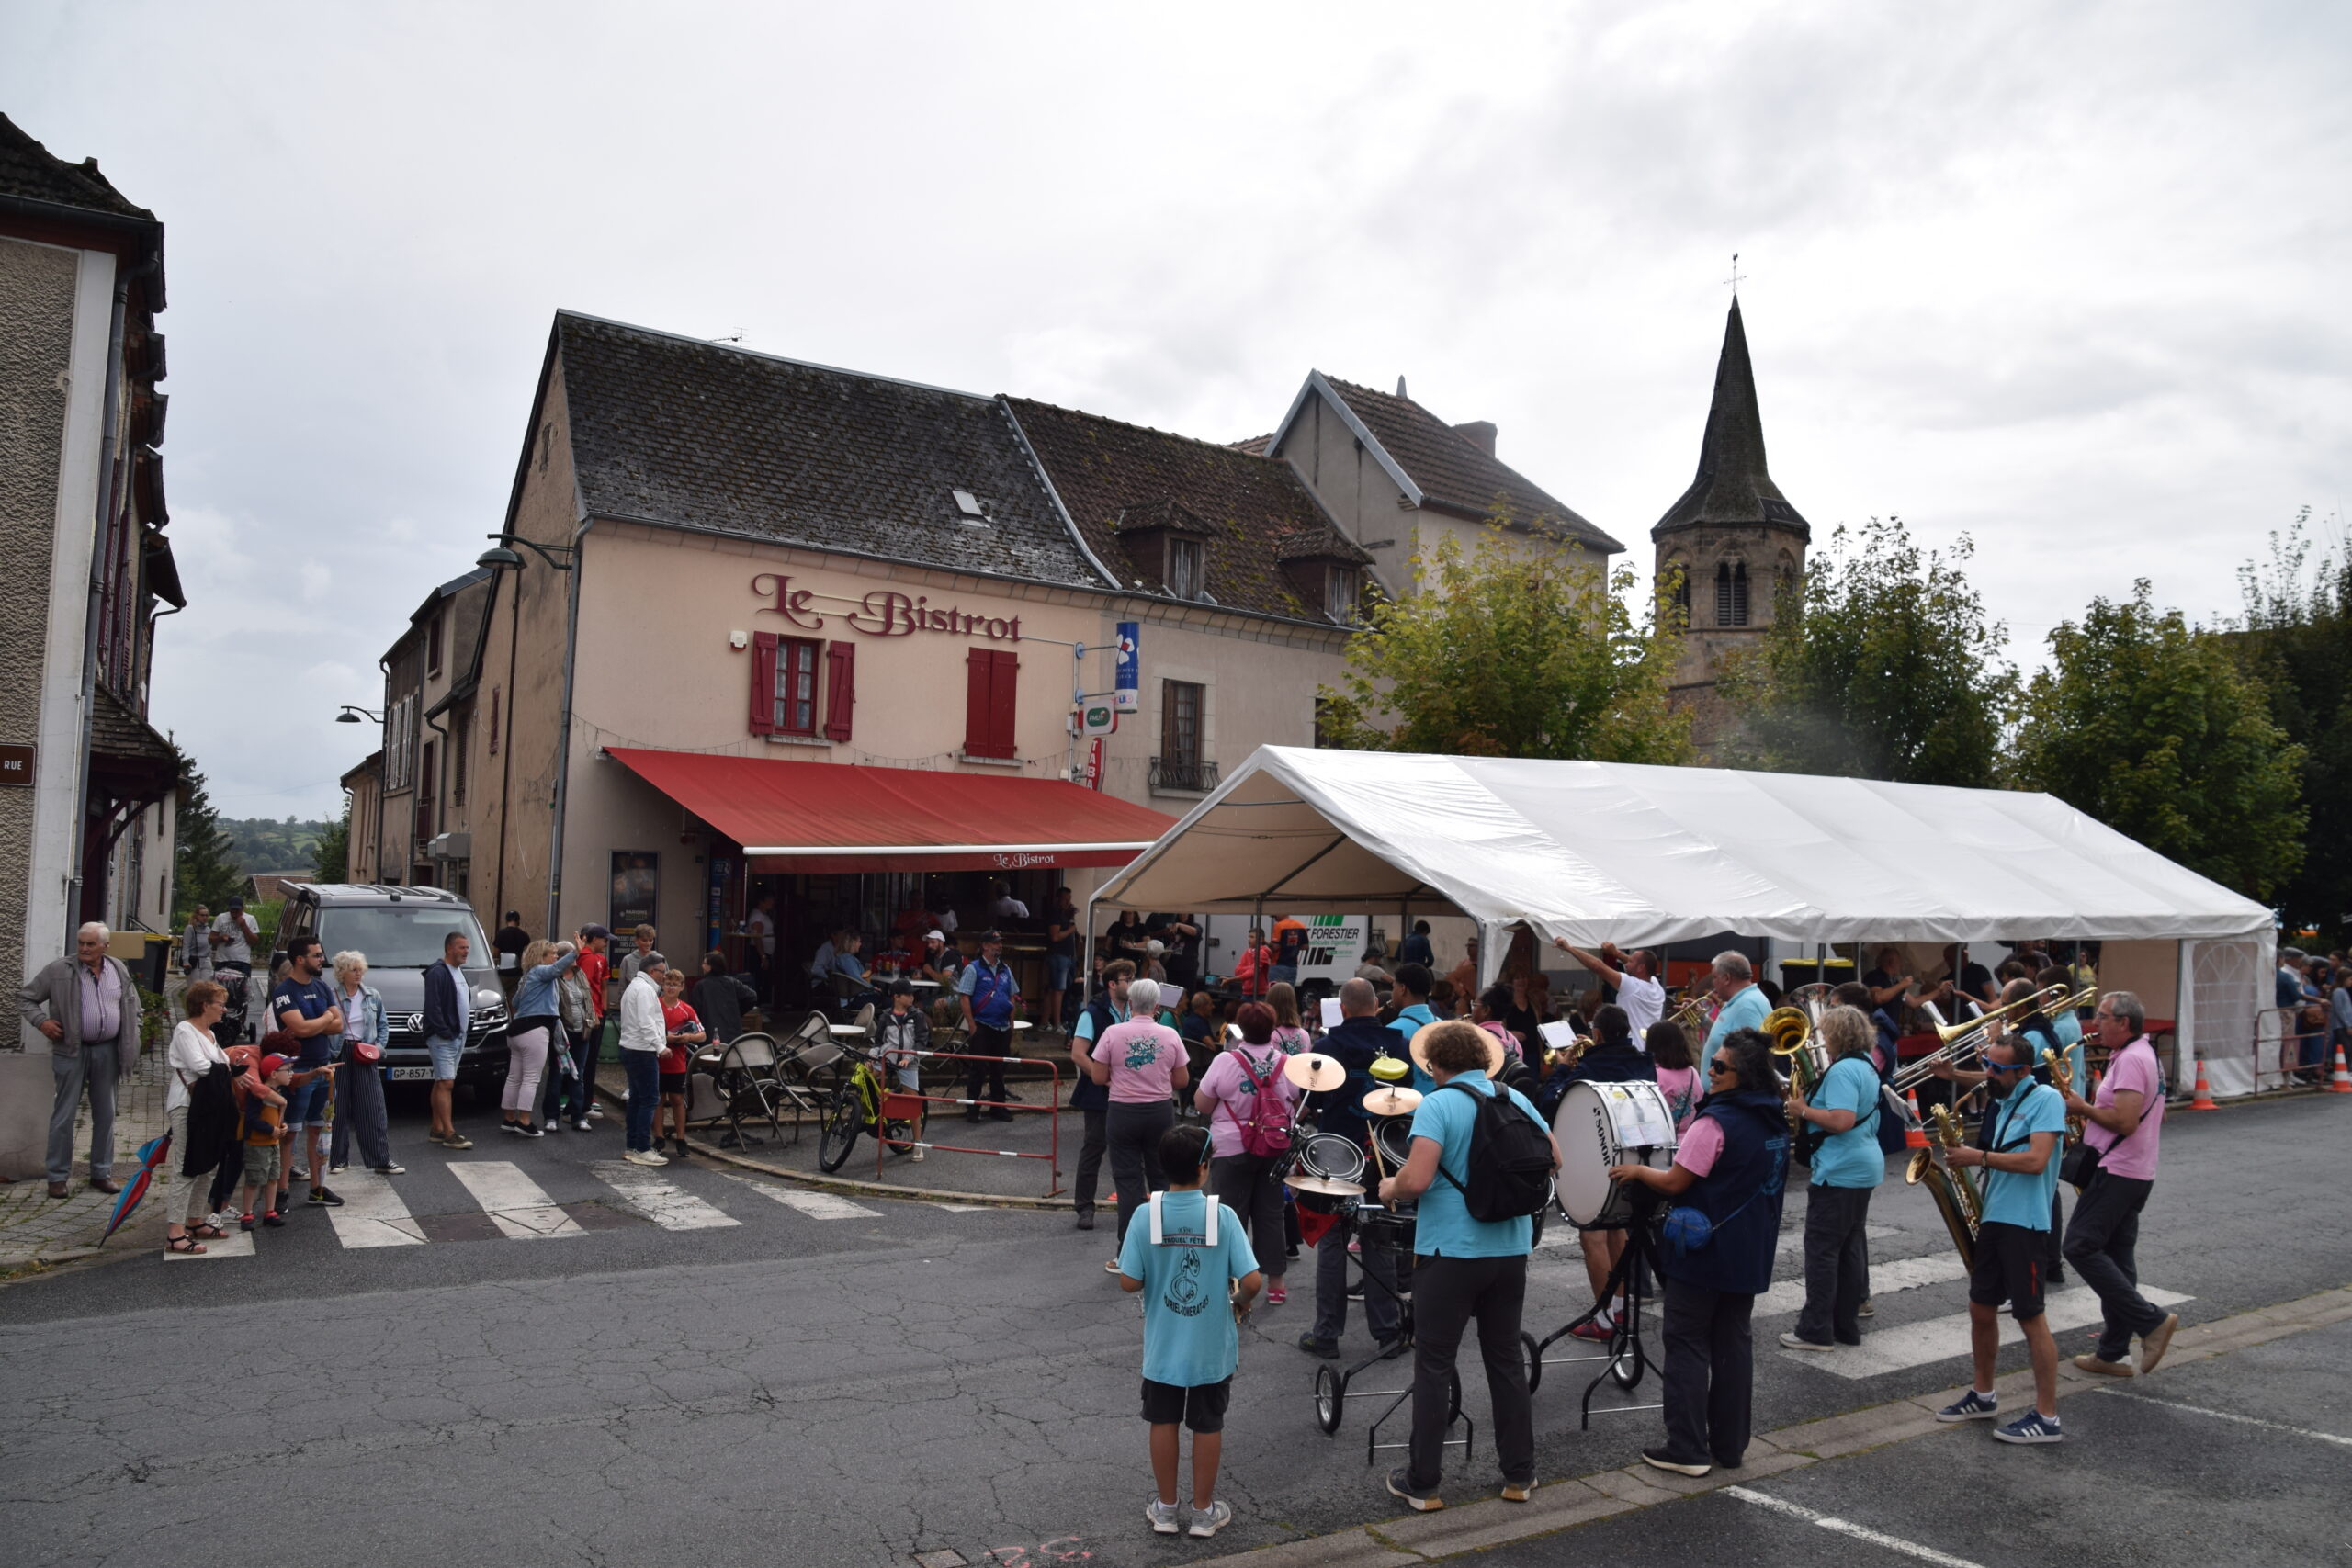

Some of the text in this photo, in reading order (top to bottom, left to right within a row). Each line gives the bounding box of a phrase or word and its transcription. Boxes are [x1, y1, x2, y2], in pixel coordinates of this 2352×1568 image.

[752, 573, 1023, 642] Le Bistrot
[1088, 714, 1102, 722] PMU
[4, 760, 23, 771] RUE
[1087, 740, 1099, 790] TABA
[993, 853, 1055, 869] Le Bistrot
[1311, 928, 1360, 939] FORESTIER
[276, 994, 291, 1009] JPN
[393, 1069, 435, 1078] GP-857-Y
[1595, 1118, 1611, 1167] SONOR
